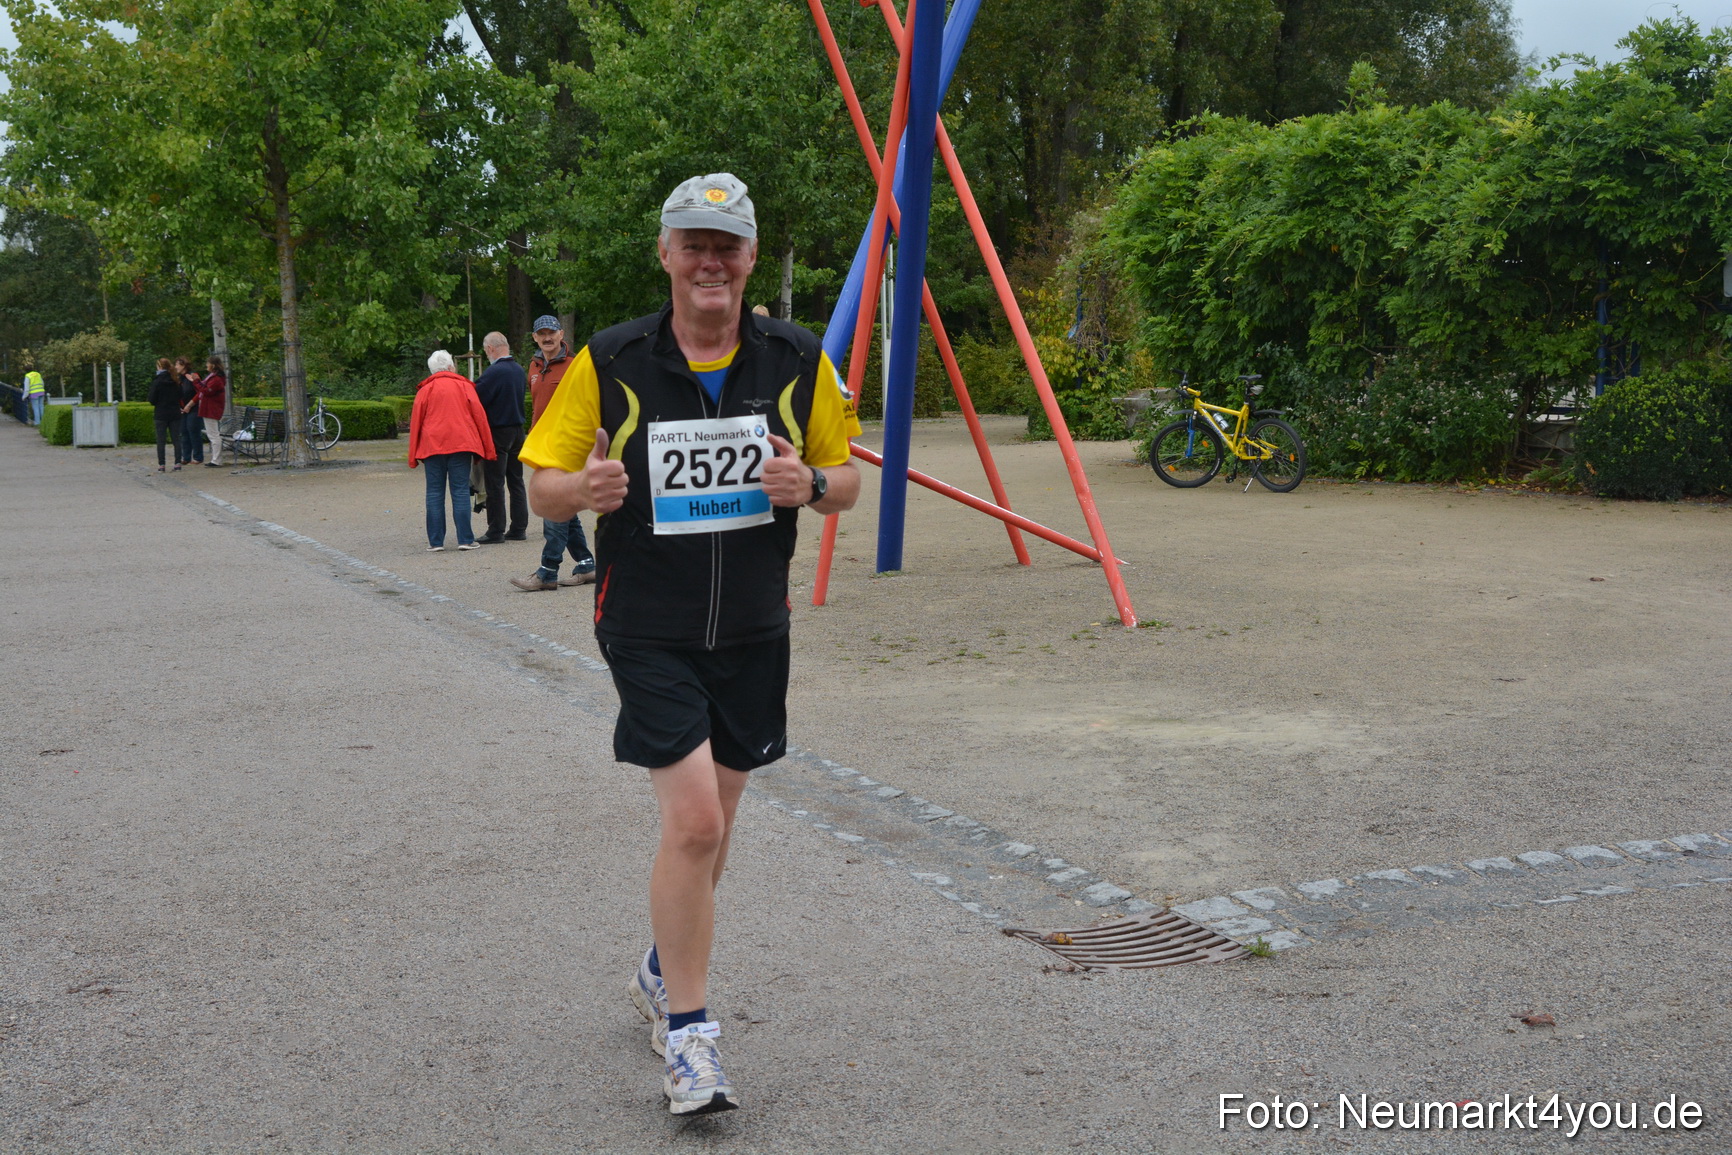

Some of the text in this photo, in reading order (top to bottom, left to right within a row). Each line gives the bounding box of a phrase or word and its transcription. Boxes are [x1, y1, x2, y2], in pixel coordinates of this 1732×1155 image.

[651, 429, 752, 443] PARTL Neumarkt
[663, 444, 762, 490] 2522
[689, 498, 741, 517] Hubert
